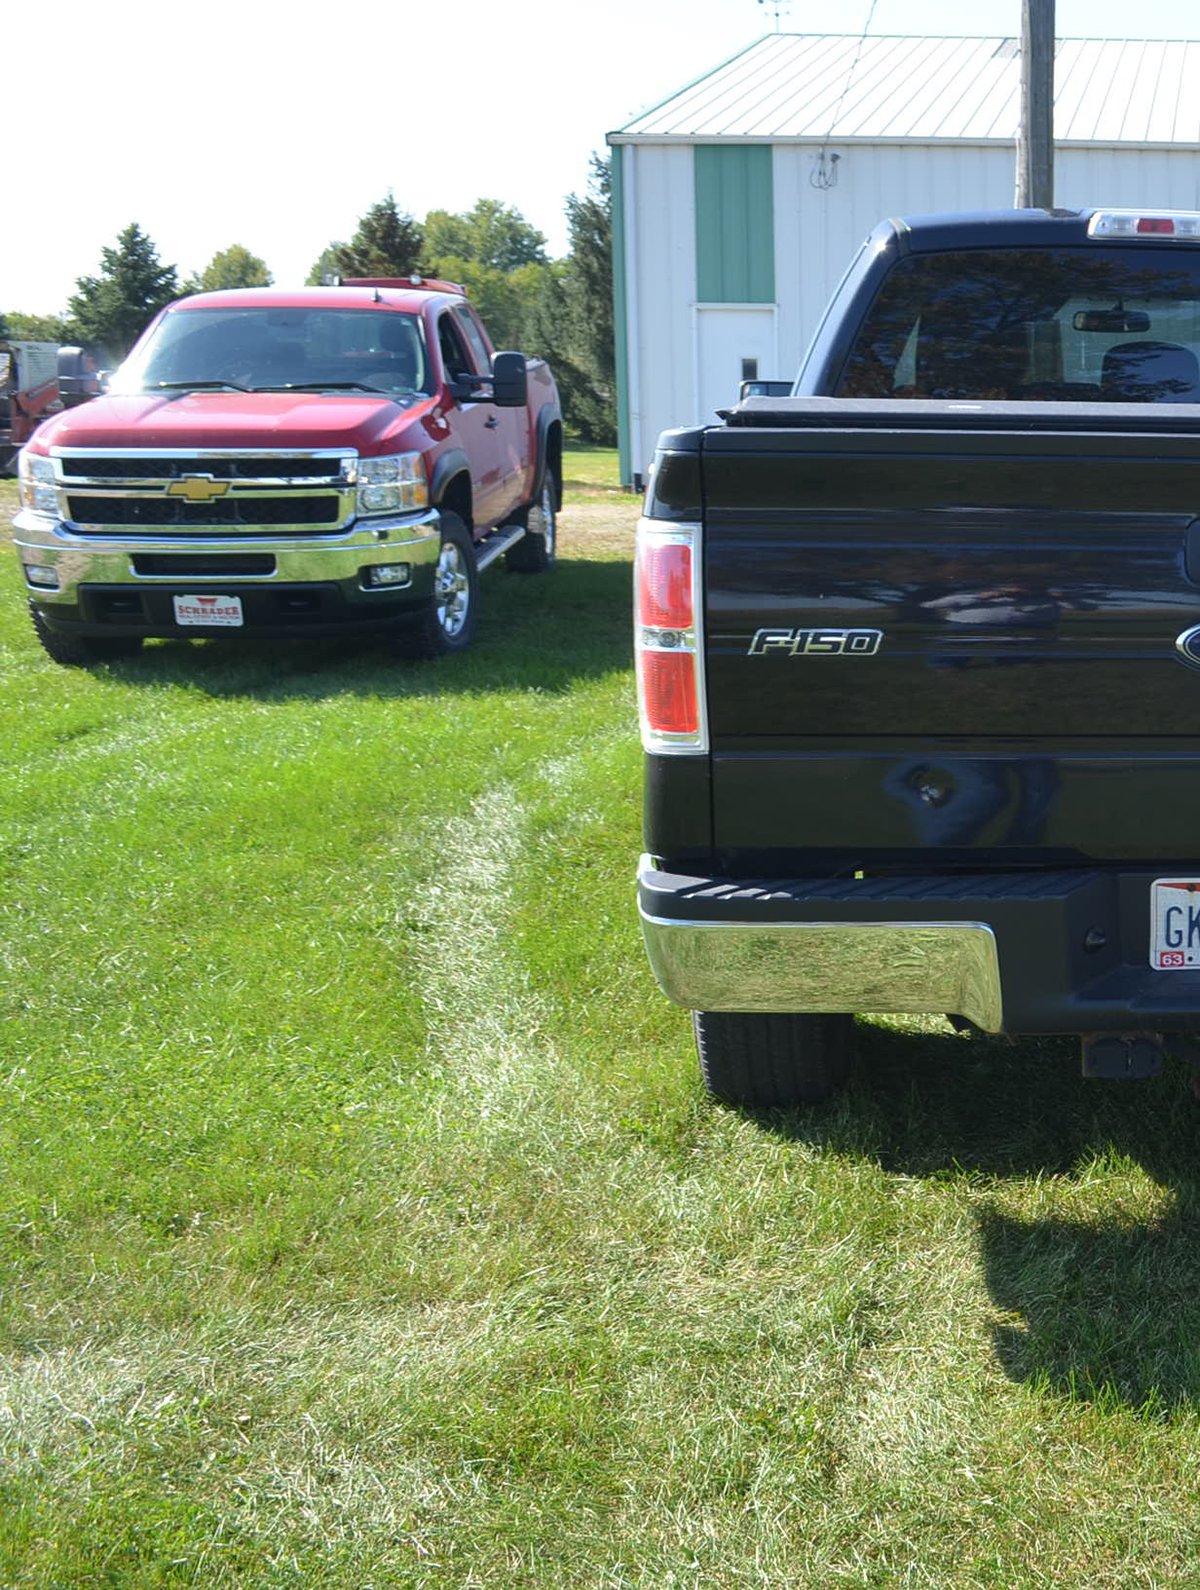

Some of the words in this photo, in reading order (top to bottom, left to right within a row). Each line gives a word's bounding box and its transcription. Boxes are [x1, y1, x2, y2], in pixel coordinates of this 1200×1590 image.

[178, 605, 239, 616] SCHRADER
[747, 627, 884, 657] F-150
[1162, 954, 1183, 966] 63
